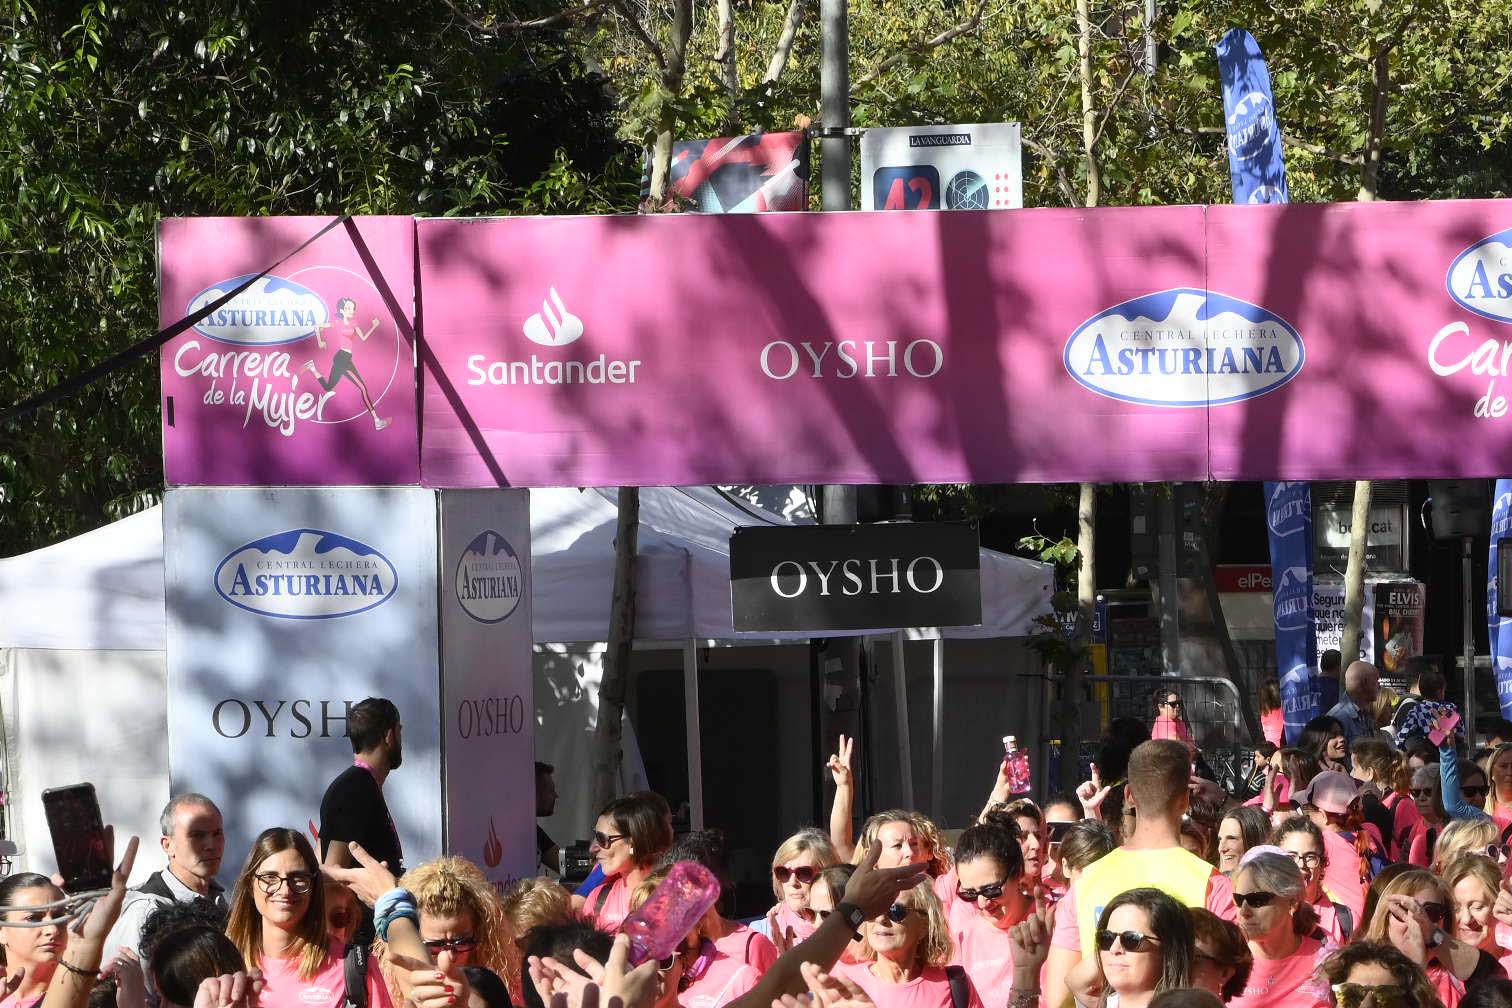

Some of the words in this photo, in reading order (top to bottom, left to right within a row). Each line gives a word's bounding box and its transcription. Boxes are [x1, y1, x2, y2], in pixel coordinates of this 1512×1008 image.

[920, 135, 970, 145] VANGUARDIA
[1120, 328, 1195, 341] CENTRAL
[175, 340, 290, 378] Carrera
[466, 353, 643, 386] Santander
[759, 338, 945, 380] OYSHO
[1083, 333, 1287, 376] ASTURIANA
[203, 380, 225, 405] de
[229, 379, 246, 405] la
[243, 372, 336, 436] Mujer
[1473, 379, 1509, 419] de
[228, 563, 385, 597] ASTURIANA
[256, 560, 315, 571] CENTRAL
[320, 560, 379, 570] LECHERA
[461, 564, 519, 600] ASTURIANA
[769, 556, 944, 599] OYSHO
[1389, 592, 1420, 605] ELVIS
[212, 698, 352, 739] OYSH
[458, 695, 525, 739] OYSHO
